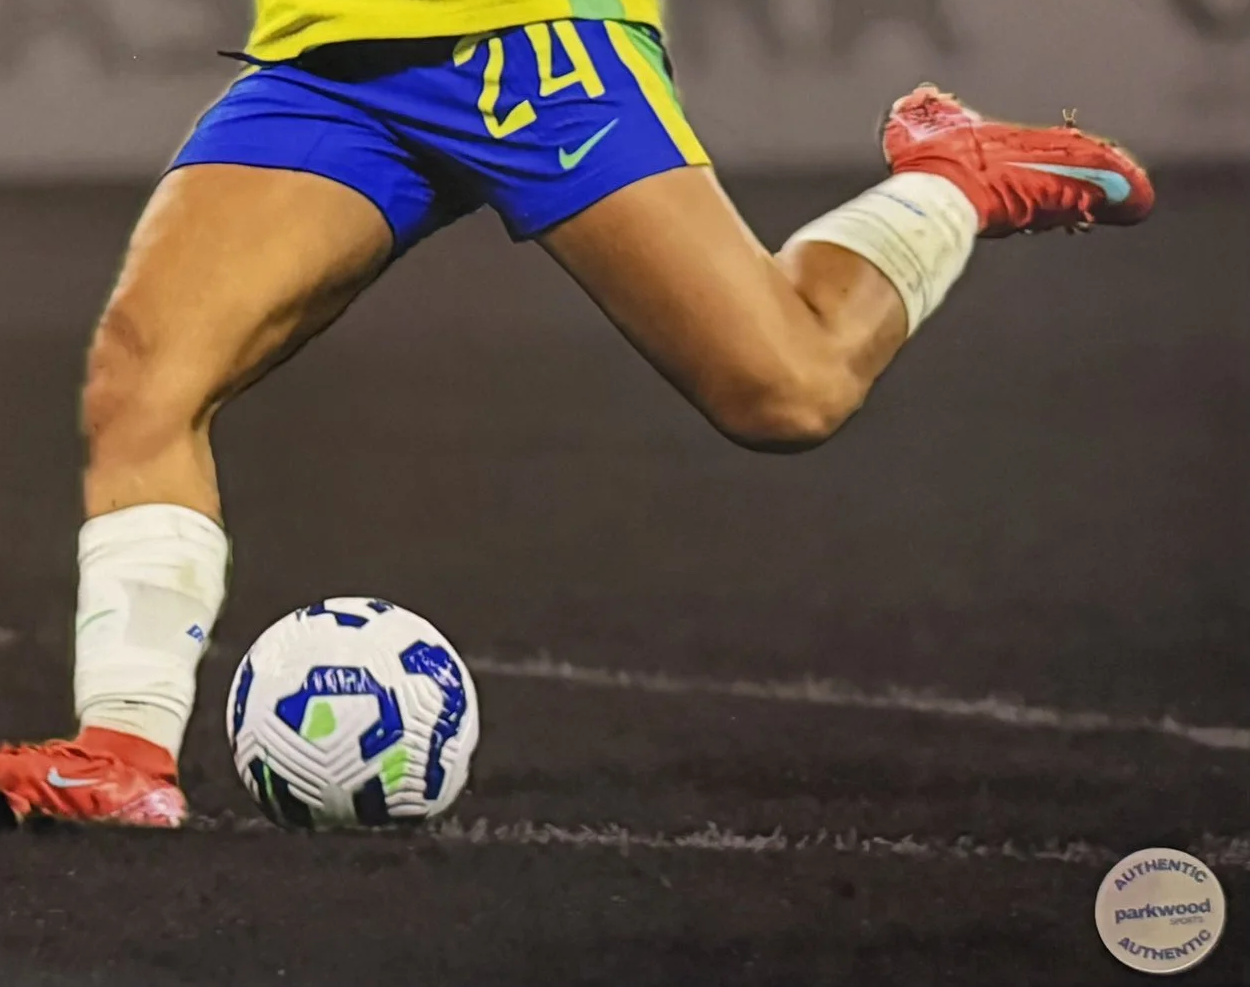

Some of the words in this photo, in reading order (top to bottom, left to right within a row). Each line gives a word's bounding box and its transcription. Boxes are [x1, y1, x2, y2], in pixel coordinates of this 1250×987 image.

[453, 19, 606, 139] 24
[1114, 858, 1208, 891] AUTHENTIC
[1114, 898, 1211, 924] parkwood
[1118, 929, 1211, 960] AUTHENTIC
